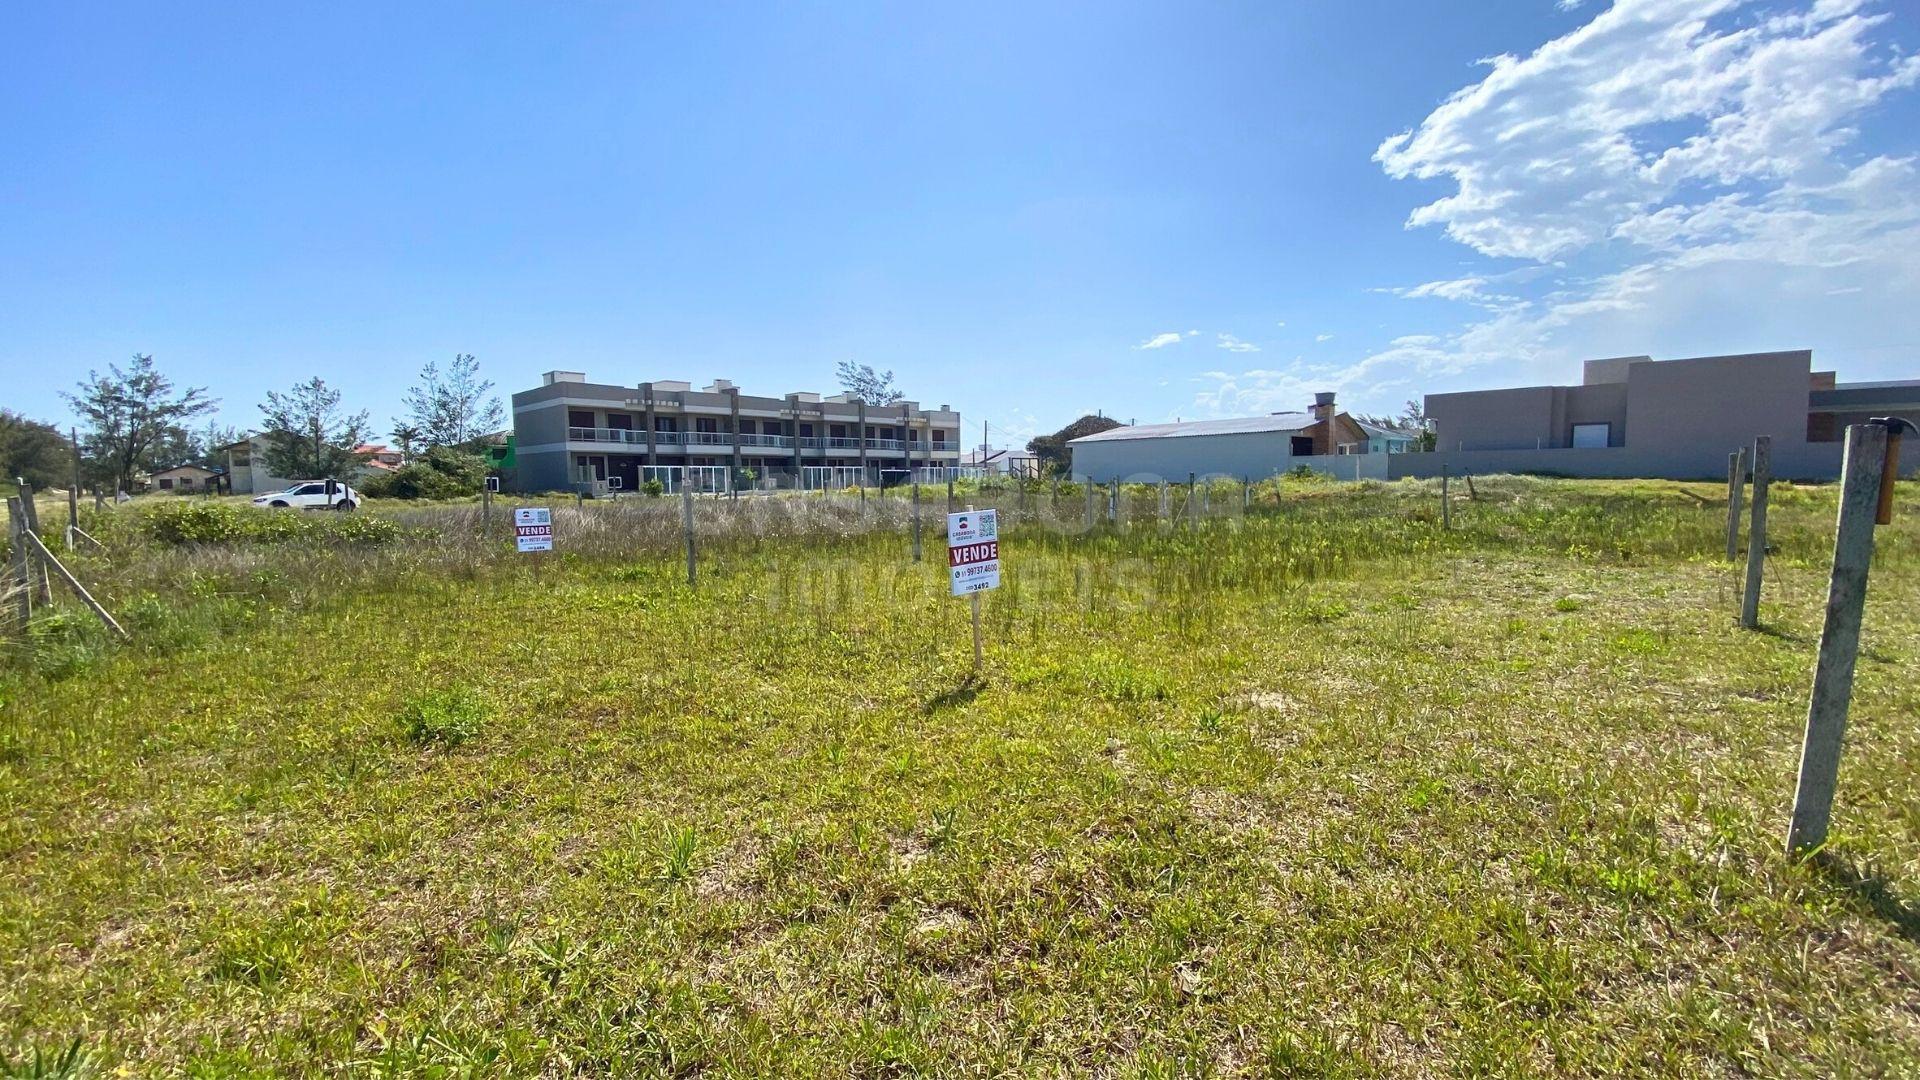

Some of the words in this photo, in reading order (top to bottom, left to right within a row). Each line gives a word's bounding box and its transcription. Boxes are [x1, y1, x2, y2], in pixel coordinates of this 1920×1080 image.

[519, 527, 551, 535] VENDE
[953, 544, 997, 564] VENDE
[974, 582, 989, 590] 3492
